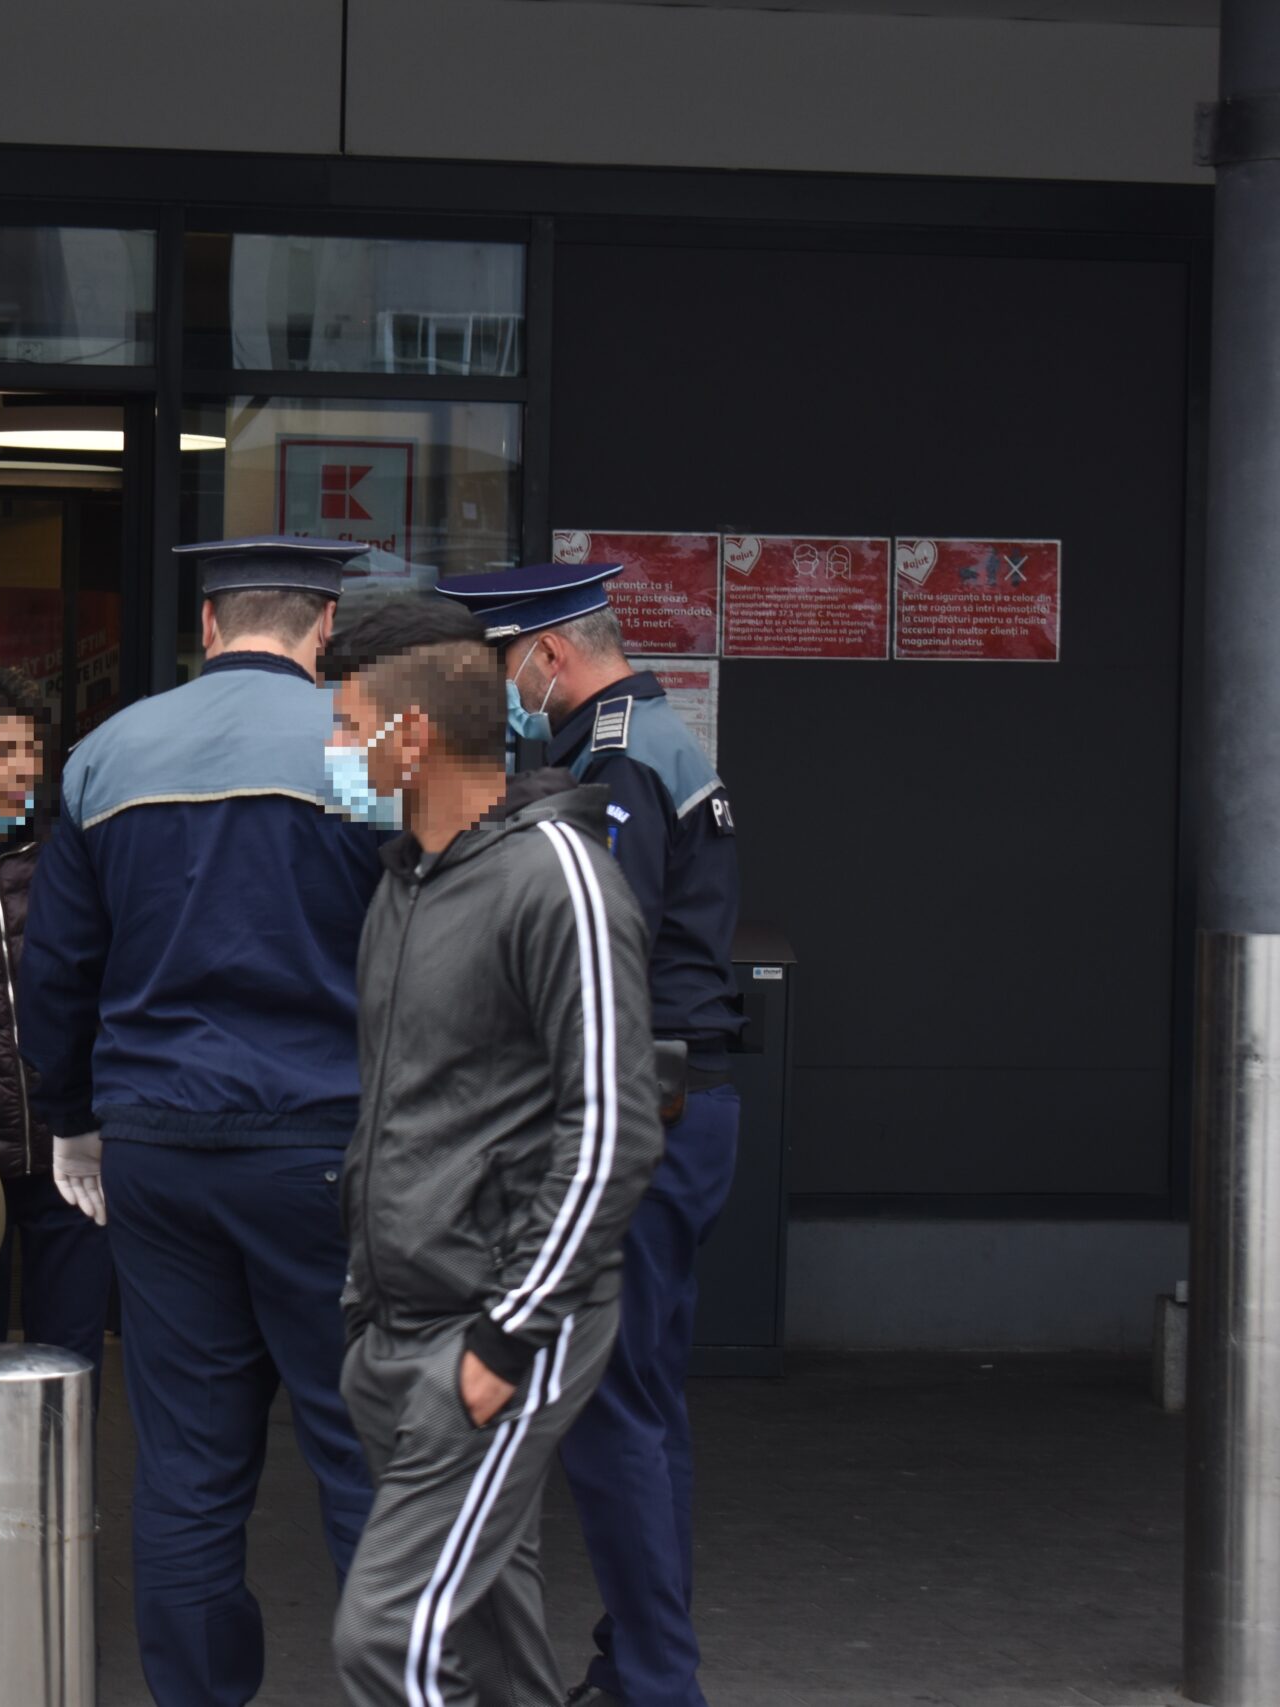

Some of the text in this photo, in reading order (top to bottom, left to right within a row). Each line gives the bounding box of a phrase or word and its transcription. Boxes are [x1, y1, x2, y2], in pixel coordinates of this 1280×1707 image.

[903, 556, 929, 570] #ajut
[650, 581, 661, 590] ta
[664, 581, 673, 592] și
[902, 591, 934, 601] Pentru
[935, 592, 980, 603] siguranța
[982, 593, 992, 602] ta
[994, 593, 1002, 603] și
[1011, 593, 1034, 602] celor
[1036, 593, 1052, 603] din
[918, 603, 929, 611] te
[930, 604, 961, 614] rugăm
[962, 604, 974, 612] să
[975, 604, 995, 612] intri
[626, 618, 640, 629] 1,5
[643, 619, 673, 629] metri.
[902, 614, 911, 623] la
[913, 614, 970, 624] cumpărături
[972, 616, 1004, 625] pentru
[1014, 615, 1047, 625] facilita
[902, 625, 936, 634] accesul
[937, 626, 955, 634] mai
[957, 626, 988, 635] multor
[990, 626, 1018, 637] clienți
[902, 636, 984, 648] magazinul nostru.
